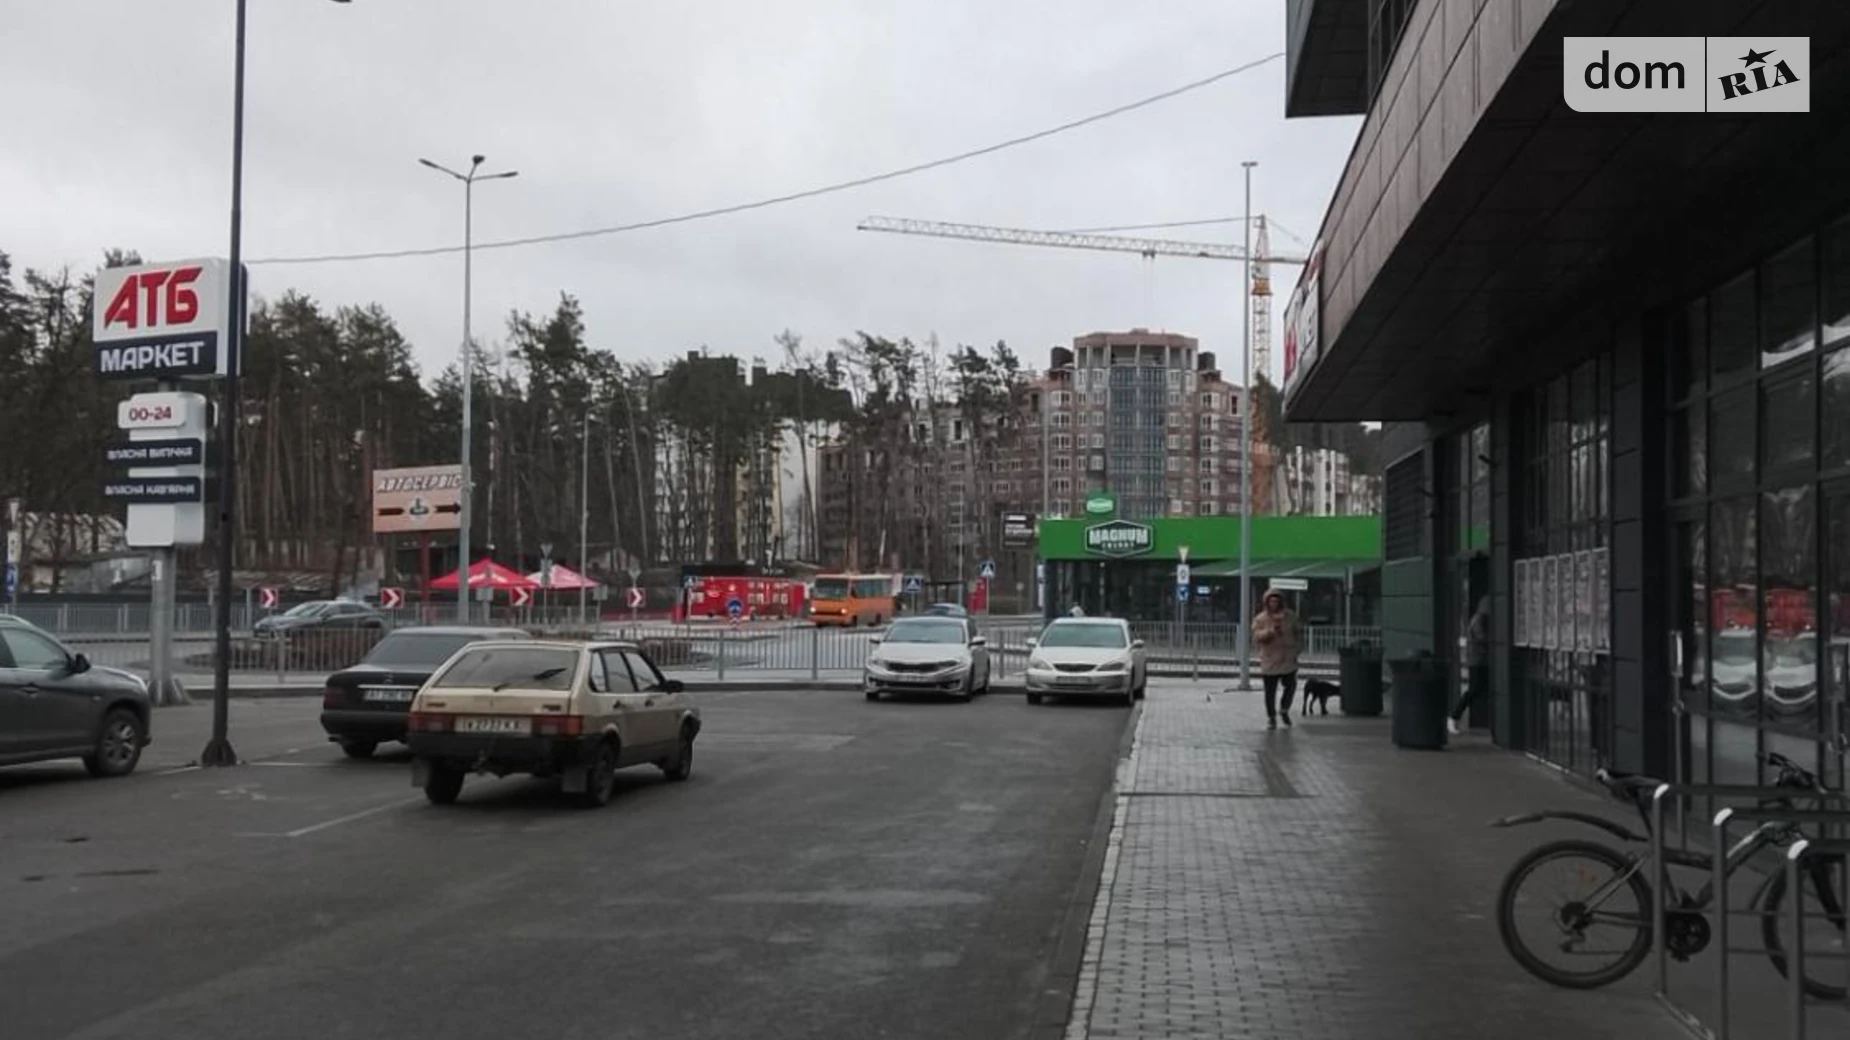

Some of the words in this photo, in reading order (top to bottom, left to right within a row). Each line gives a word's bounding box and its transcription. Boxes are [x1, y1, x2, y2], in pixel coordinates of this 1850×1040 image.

[104, 267, 203, 330] АТБ
[101, 341, 205, 372] МАРКЕТ
[129, 406, 172, 421] 00-24
[1089, 528, 1149, 545] MAGNUM
